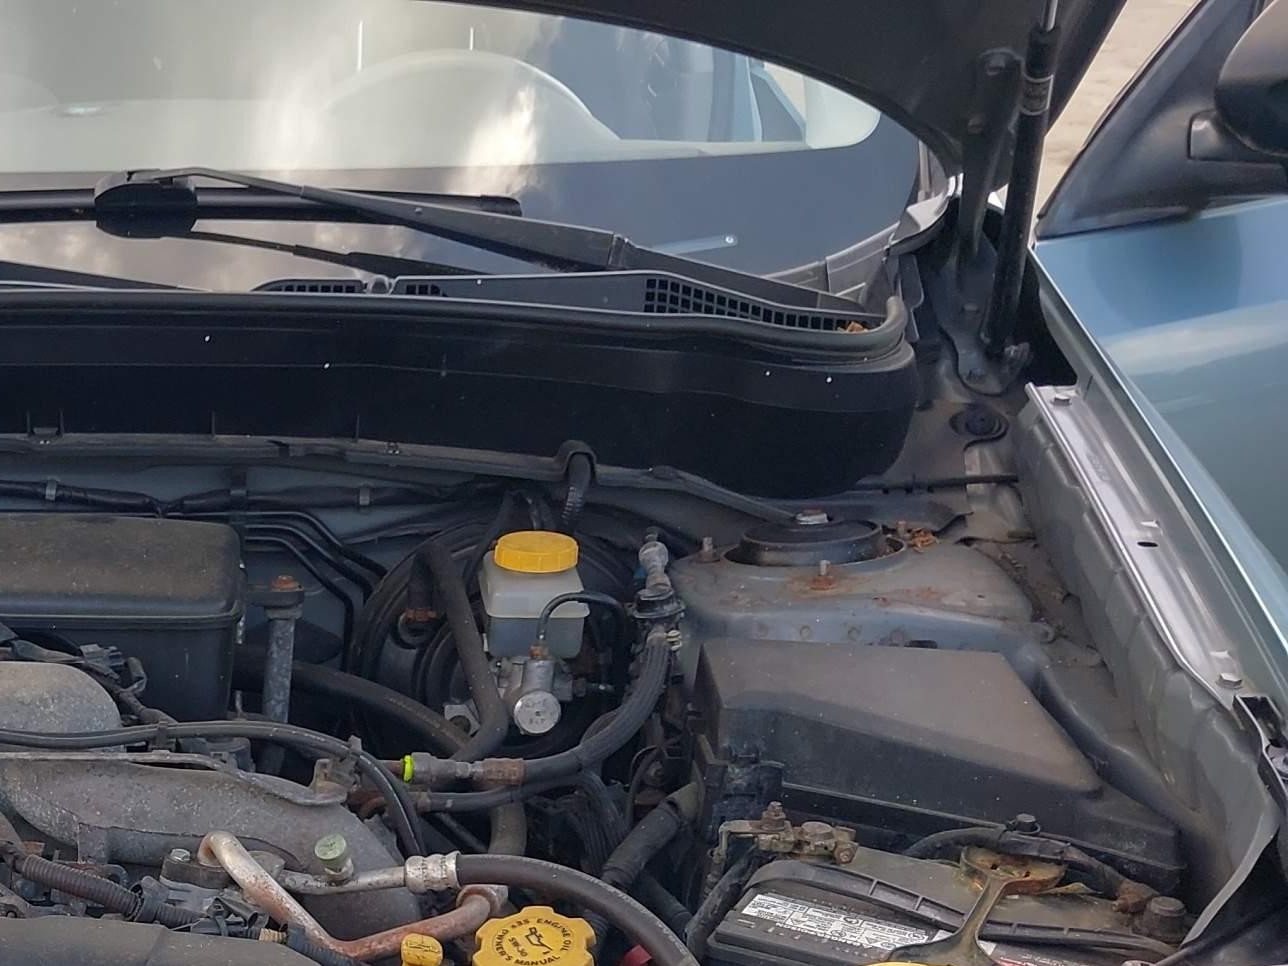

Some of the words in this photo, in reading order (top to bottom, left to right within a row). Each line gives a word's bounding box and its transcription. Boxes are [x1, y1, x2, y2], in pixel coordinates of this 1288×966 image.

[495, 929, 514, 962] OWNER'S
[514, 954, 561, 966] MANUAL
[507, 936, 529, 958] 5W-30
[536, 917, 571, 938] ENGINE
[560, 939, 572, 952] OIL
